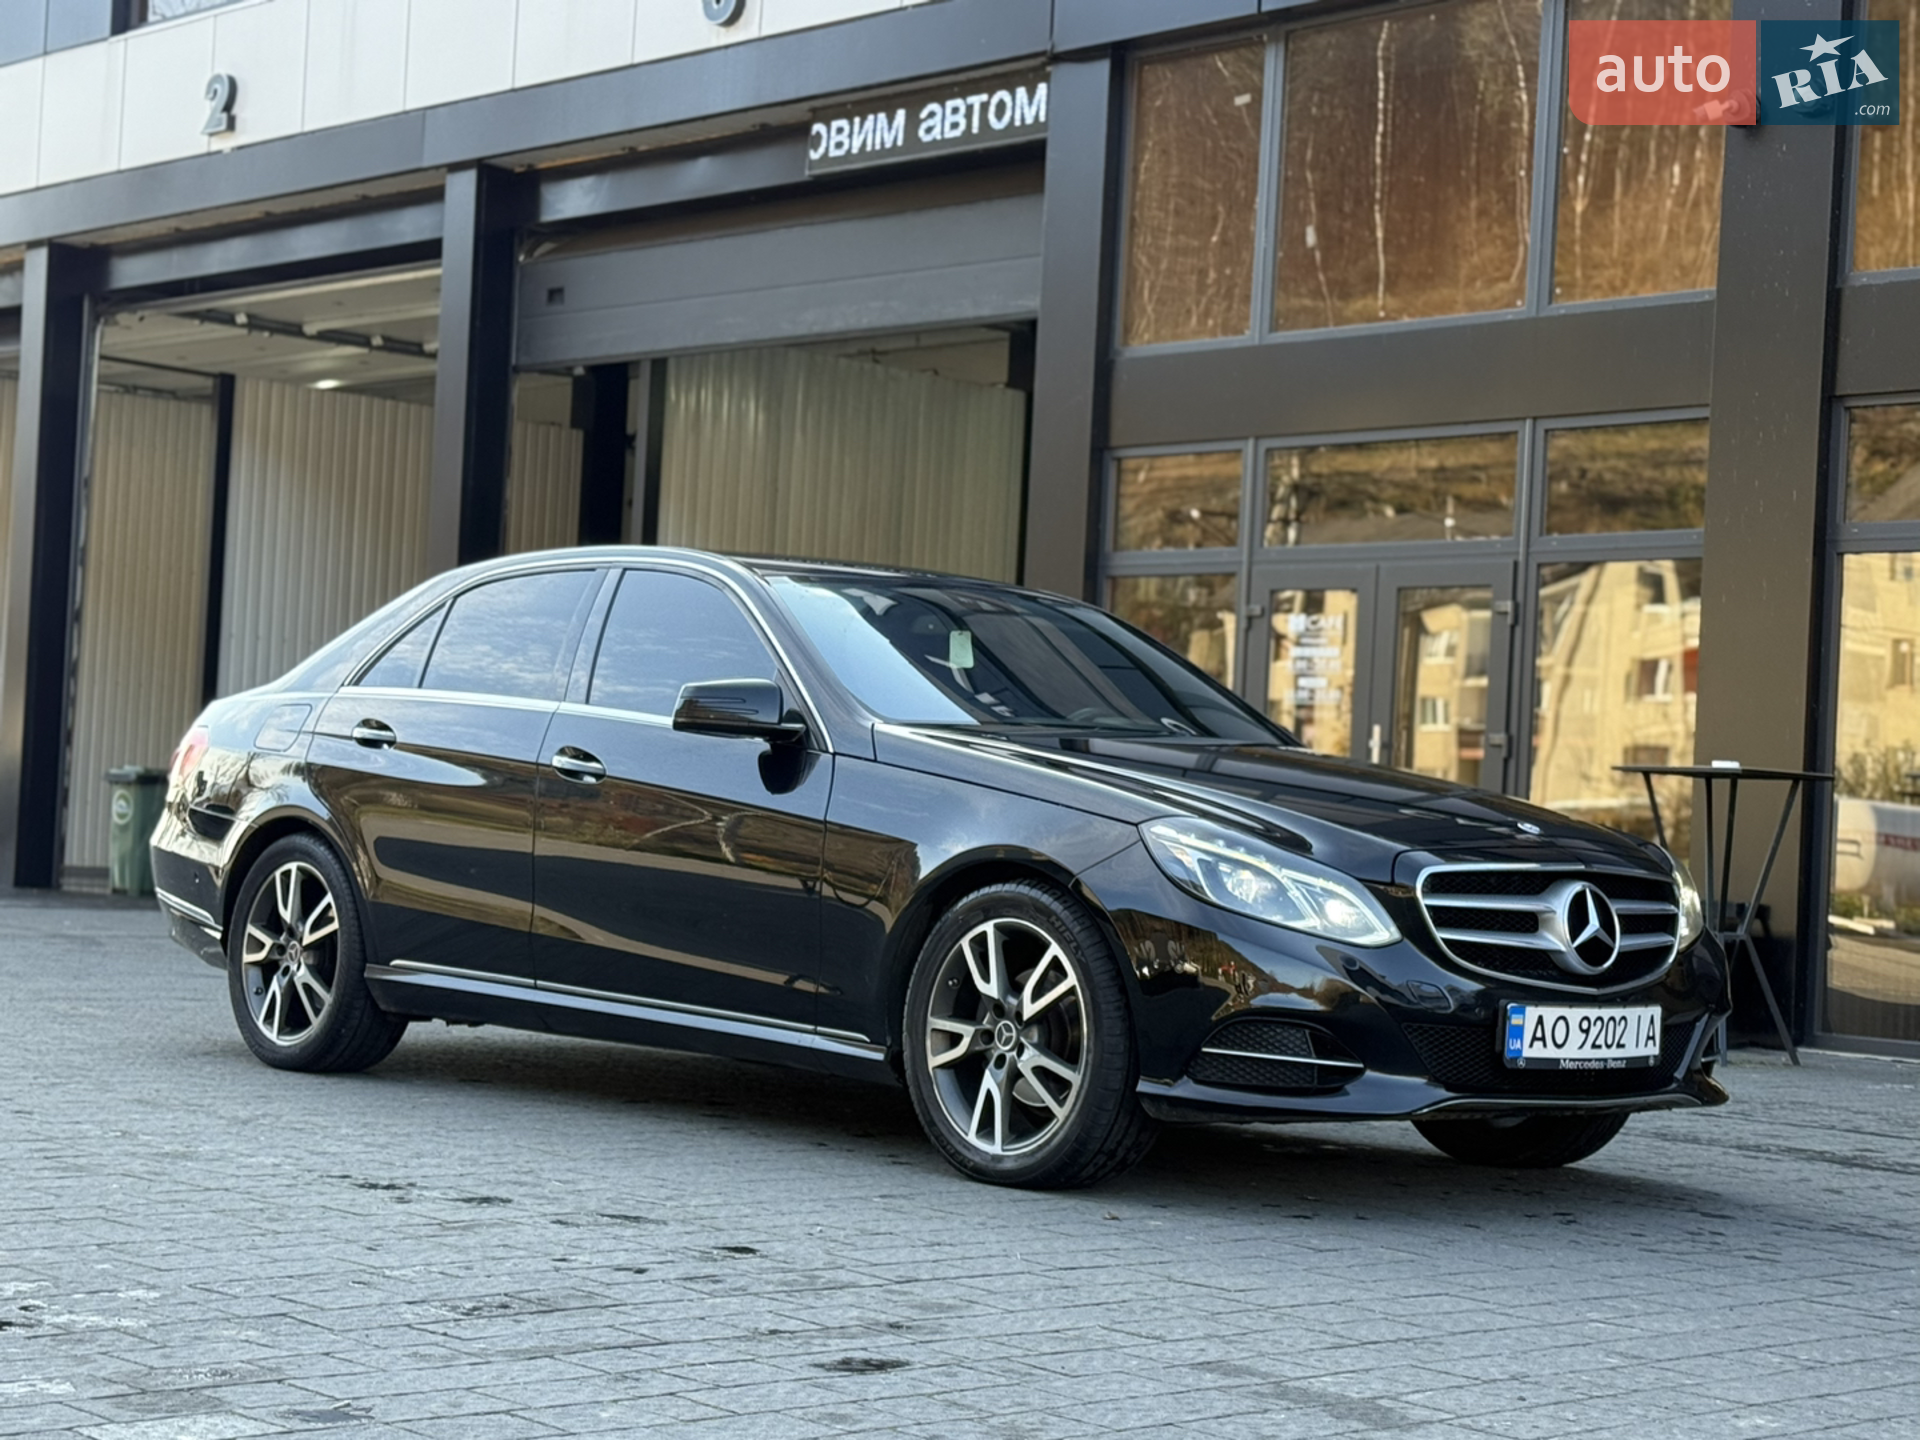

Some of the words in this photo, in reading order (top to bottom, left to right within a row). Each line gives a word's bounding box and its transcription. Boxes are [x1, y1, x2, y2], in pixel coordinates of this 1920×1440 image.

[200, 73, 237, 135] 2
[1509, 1039, 1521, 1050] UA
[1529, 1014, 1570, 1050] AO
[1578, 1015, 1628, 1050] 9202
[1635, 1014, 1657, 1048] IA
